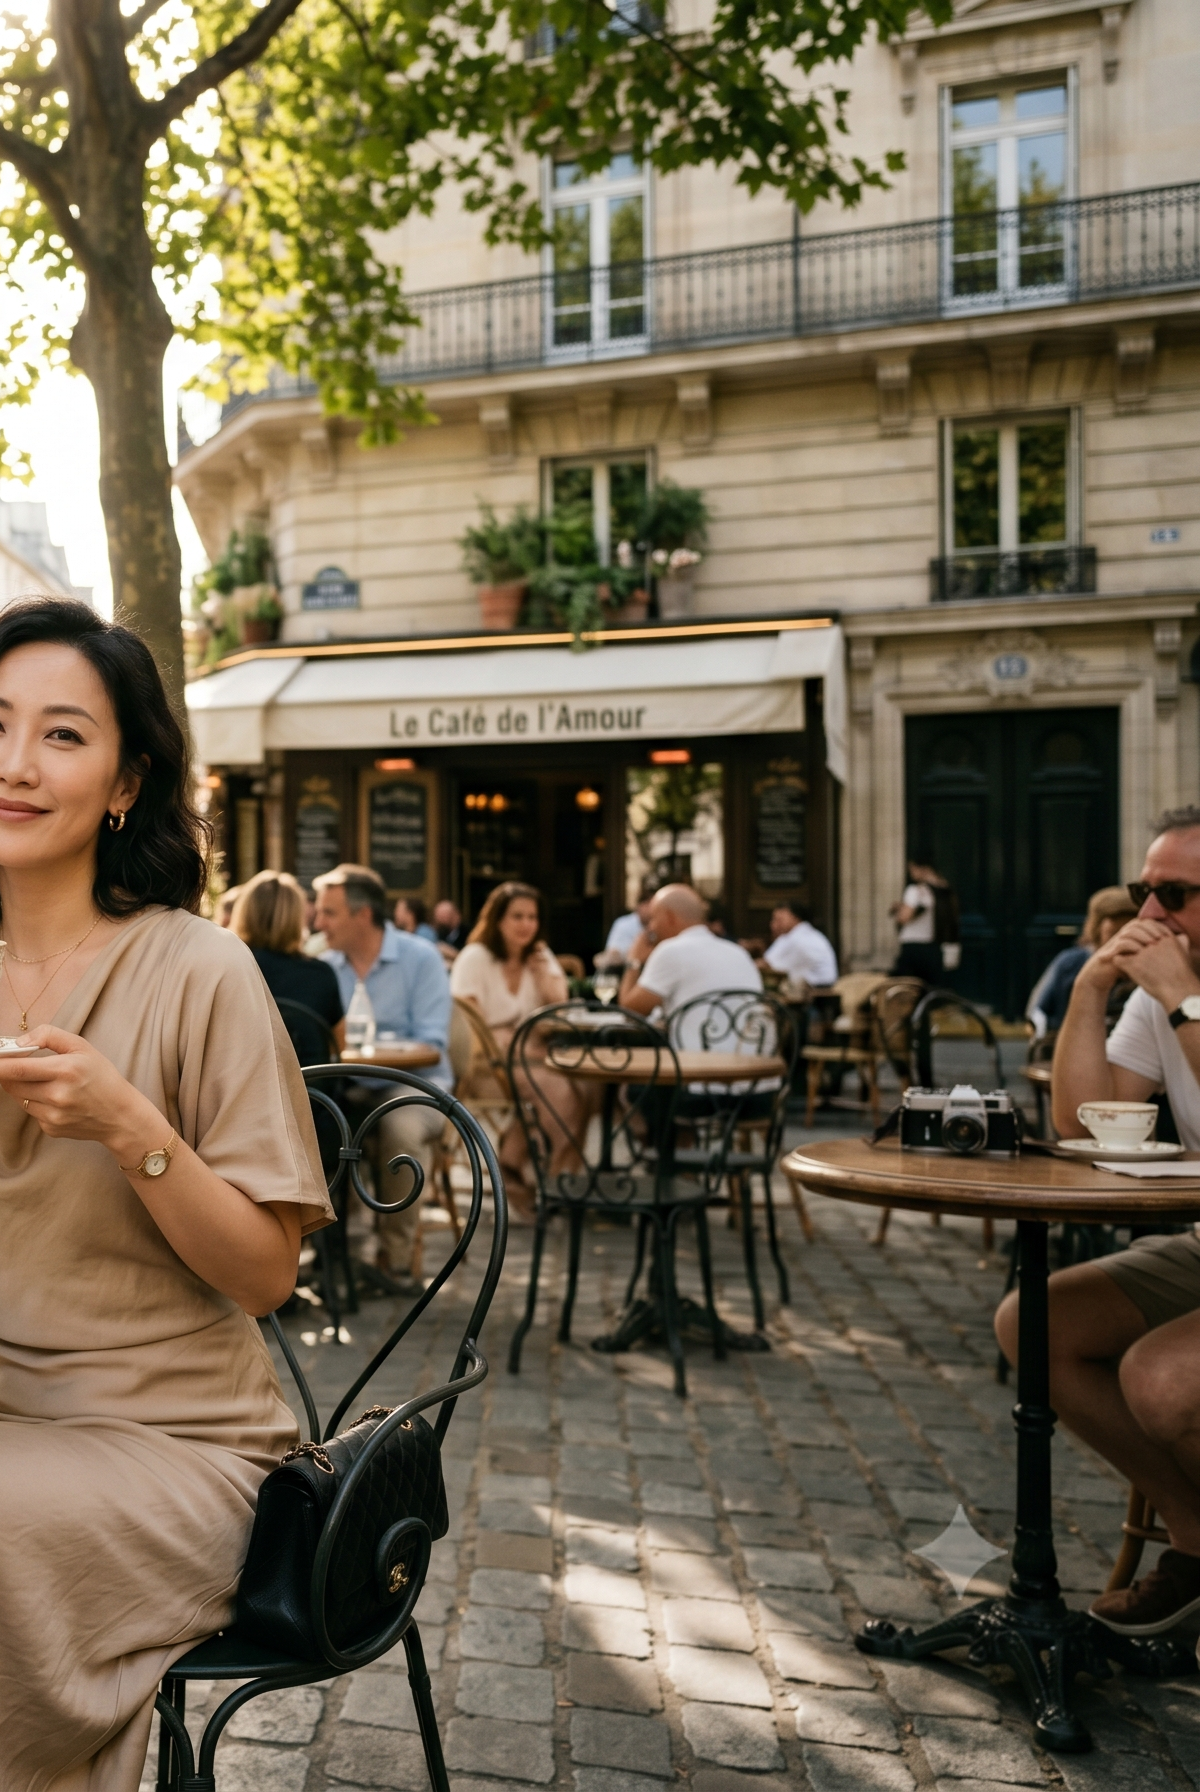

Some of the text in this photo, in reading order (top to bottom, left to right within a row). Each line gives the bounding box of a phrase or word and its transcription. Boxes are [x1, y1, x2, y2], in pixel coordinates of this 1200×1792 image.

[389, 702, 647, 738] Le Café de l'Amour
